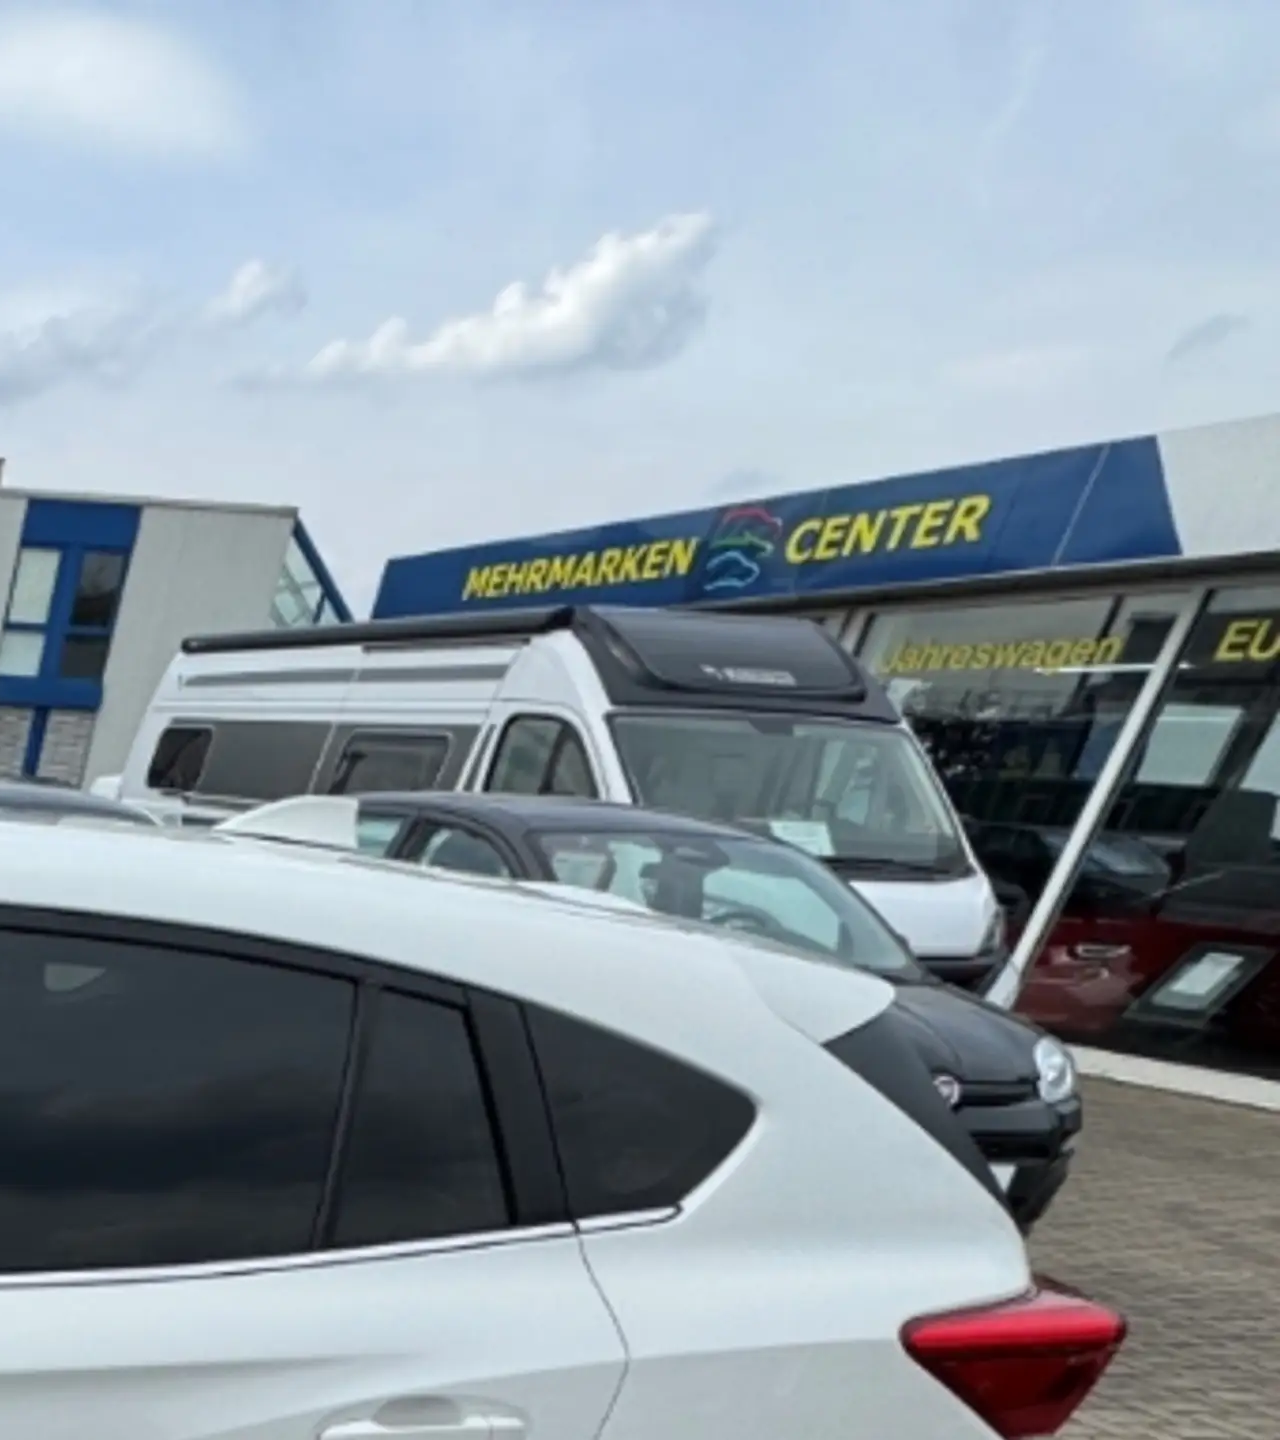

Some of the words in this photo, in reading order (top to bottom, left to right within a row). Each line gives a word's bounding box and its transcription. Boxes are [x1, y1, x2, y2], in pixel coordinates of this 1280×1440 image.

[462, 537, 699, 600] MEHRMARKEN
[786, 495, 990, 563] CENTER
[878, 634, 1122, 677] Jahreswagen
